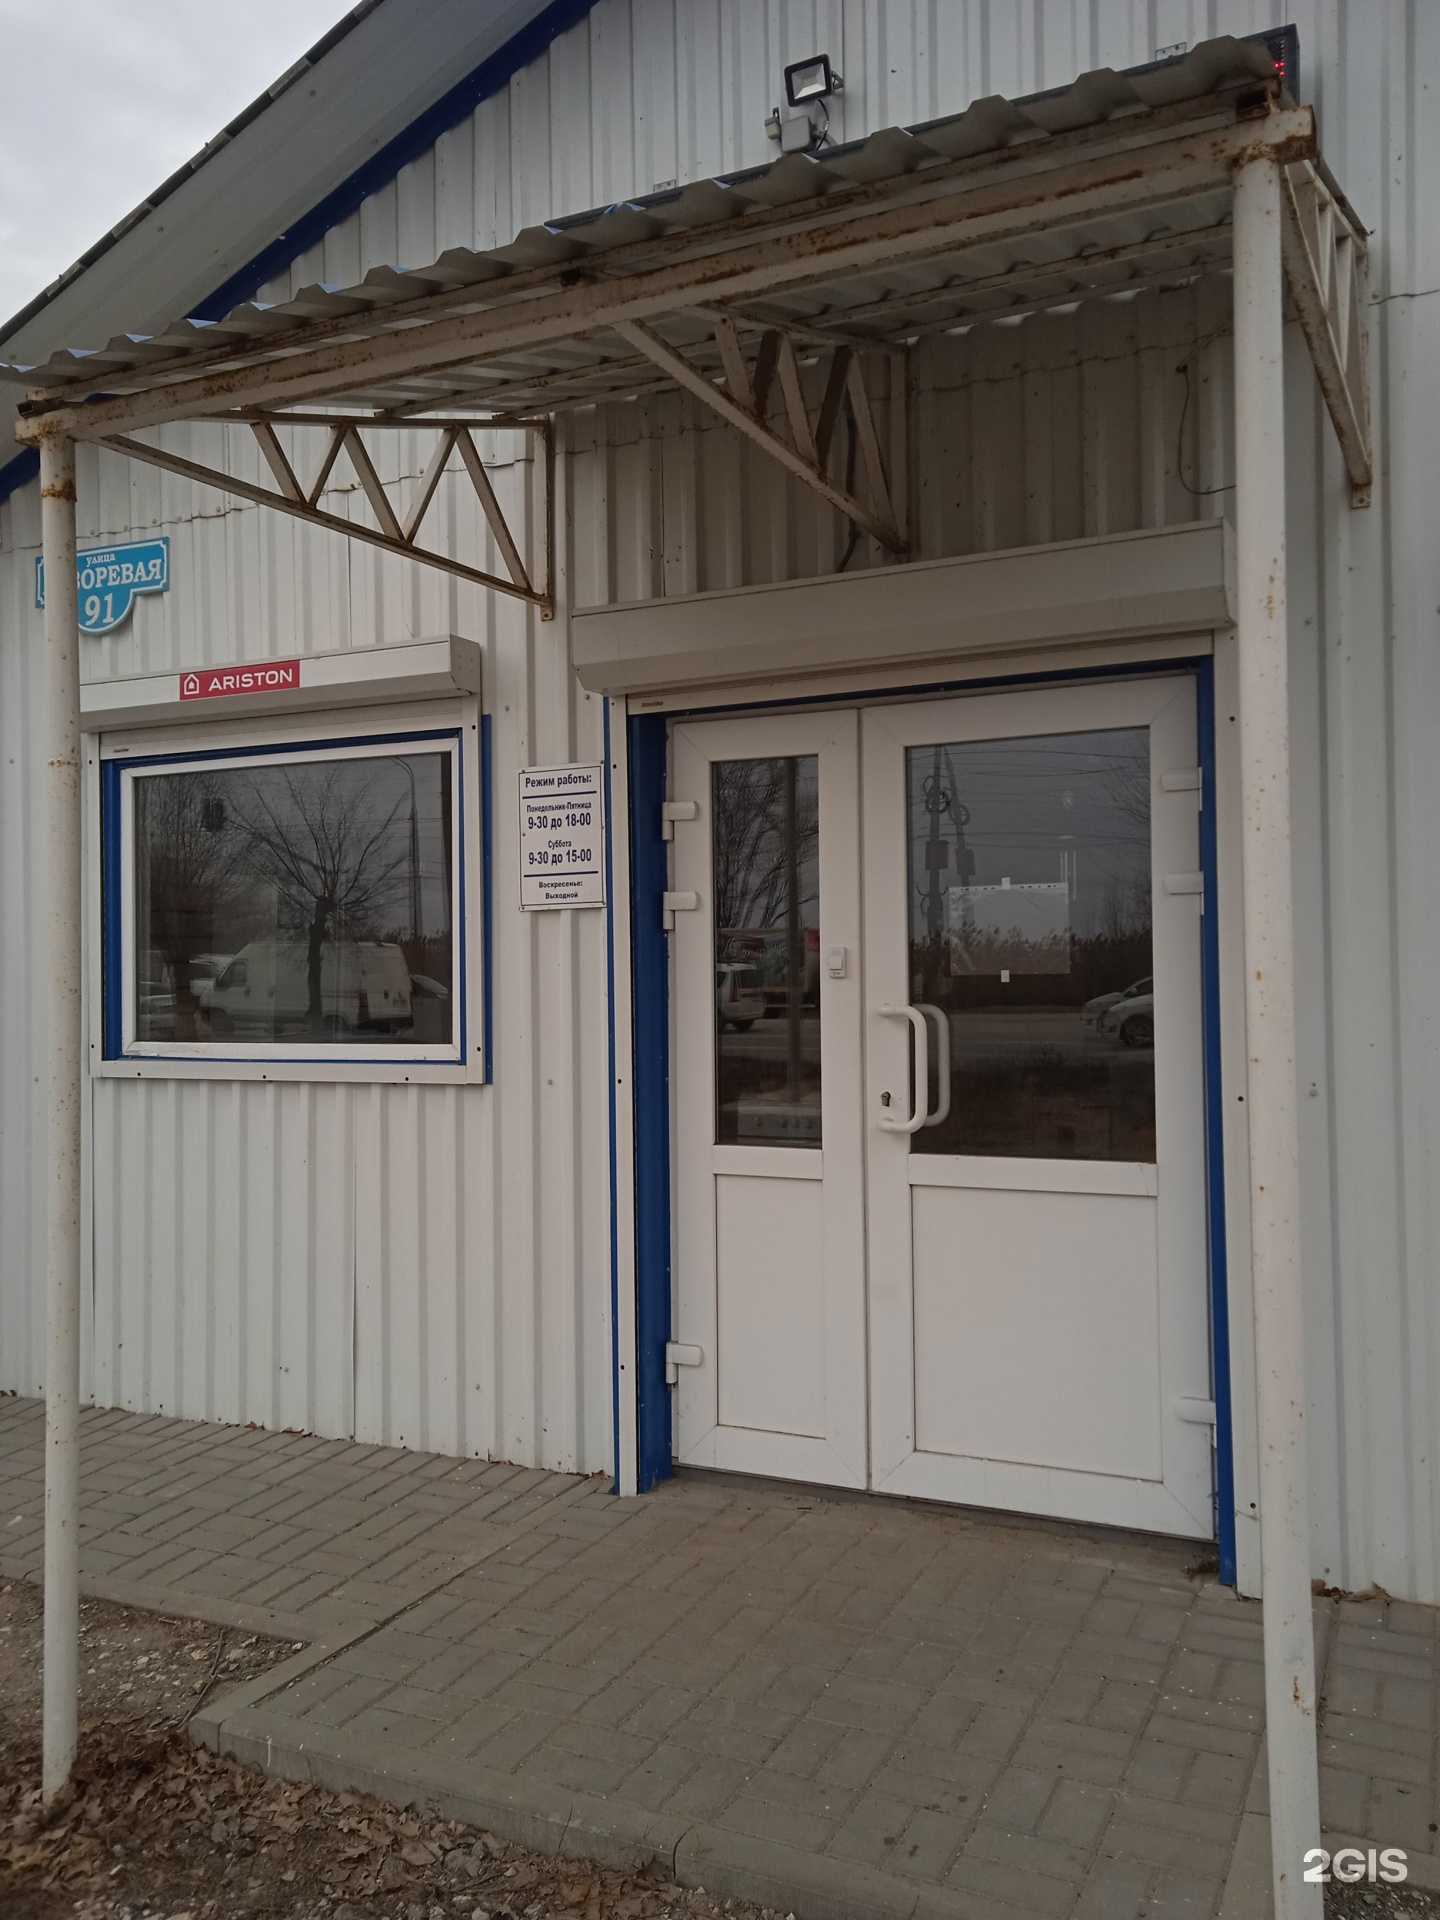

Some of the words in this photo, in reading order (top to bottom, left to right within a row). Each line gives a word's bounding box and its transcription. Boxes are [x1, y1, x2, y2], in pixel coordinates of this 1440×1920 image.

[86, 553, 116, 567] улица
[76, 559, 162, 590] ОРЕВАЯ
[84, 593, 115, 626] 91
[208, 669, 293, 692] ARISTON
[525, 777, 555, 788] Режим
[557, 774, 592, 788] работы:
[528, 816, 548, 829] 9-30
[550, 817, 562, 830] до
[565, 813, 591, 826] 18-00
[548, 840, 572, 850] Суббота
[528, 851, 549, 865] 9-30
[551, 853, 563, 866] до
[566, 849, 592, 862] 15-00
[545, 892, 578, 900] Выходной
